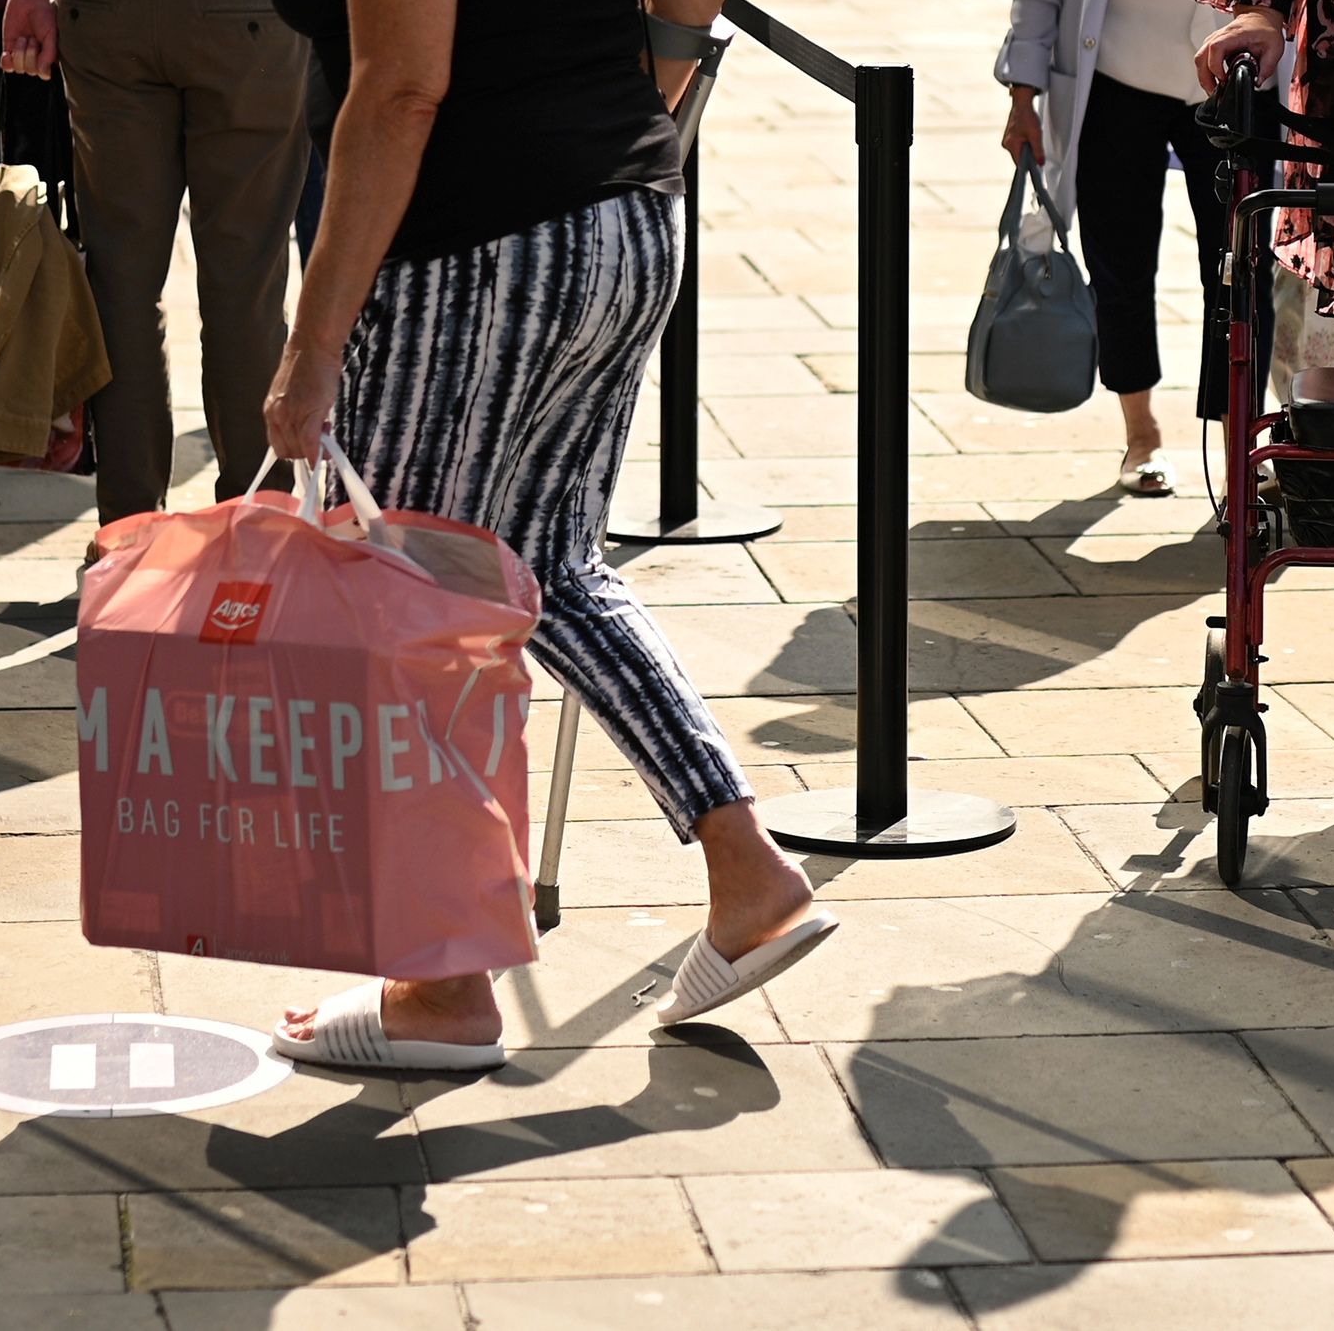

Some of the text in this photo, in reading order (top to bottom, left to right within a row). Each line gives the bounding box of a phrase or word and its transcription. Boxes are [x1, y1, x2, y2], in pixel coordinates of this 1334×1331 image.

[213, 598, 262, 622] Argos
[137, 687, 174, 776] A
[117, 797, 345, 853] BAG FOR LIFE
